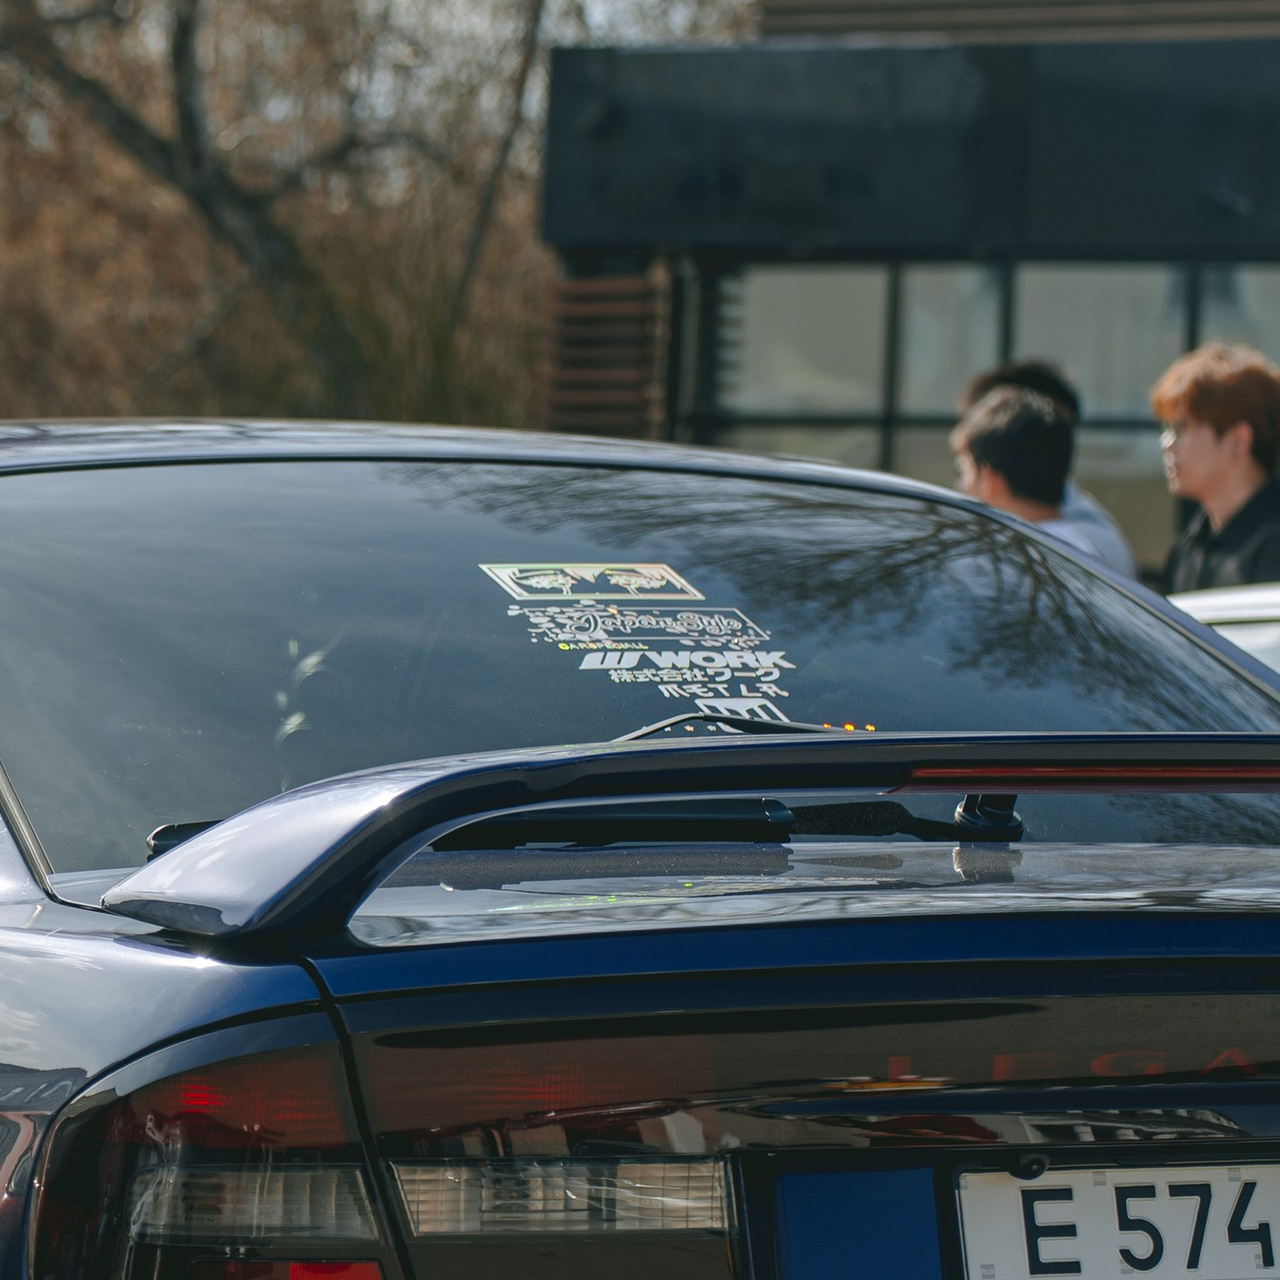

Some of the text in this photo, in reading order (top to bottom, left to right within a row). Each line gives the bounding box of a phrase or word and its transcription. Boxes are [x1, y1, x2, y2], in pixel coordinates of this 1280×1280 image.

[643, 651, 797, 670] WORK
[608, 668, 781, 683] 株式会社ワーク
[1114, 1180, 1276, 1272] 574
